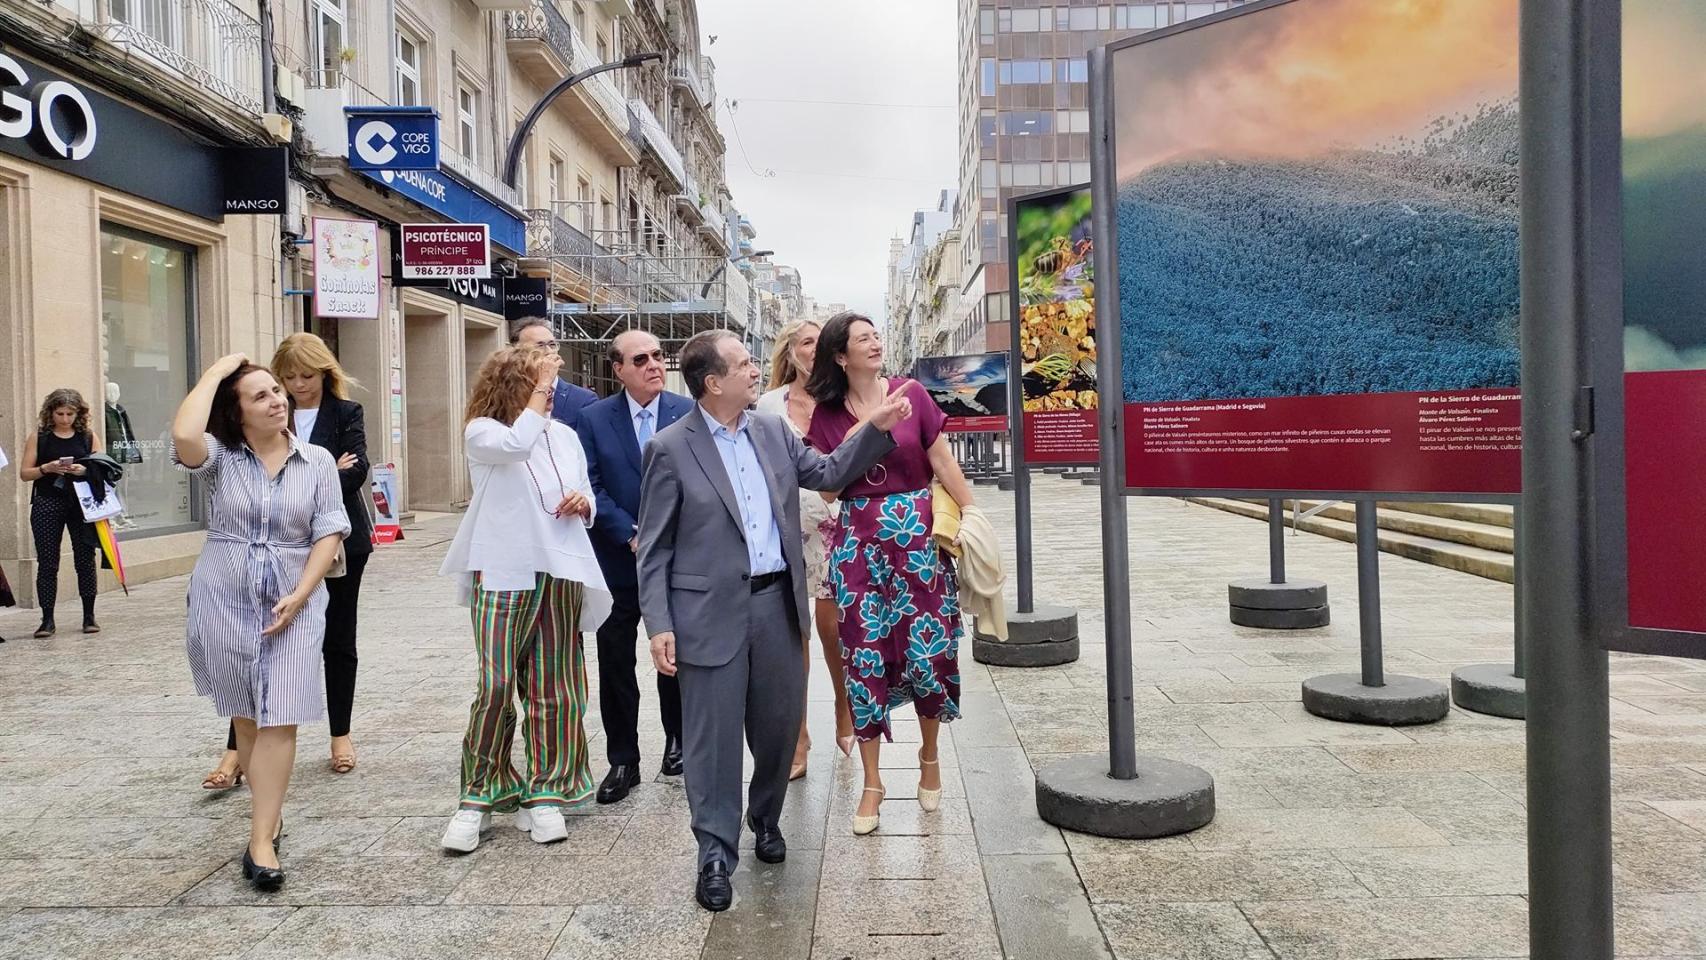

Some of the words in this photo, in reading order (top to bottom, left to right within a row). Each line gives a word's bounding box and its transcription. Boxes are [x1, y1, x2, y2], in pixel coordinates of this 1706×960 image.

[402, 132, 430, 143] COPE
[402, 143, 431, 154] VIGO
[427, 178, 447, 202] COPE
[226, 199, 279, 209] MANGO
[405, 229, 482, 243] PSICOTÉCNICO
[420, 246, 469, 256] PRÍNCIPE
[415, 266, 434, 275] 986
[436, 266, 454, 275] 227
[457, 266, 475, 275] 888
[320, 275, 376, 295] Gominolas
[482, 284, 496, 298] MAN
[506, 294, 544, 302] MANGO
[328, 297, 367, 313] Snack
[1182, 404, 1215, 412] Guadarrama
[1216, 403, 1237, 411] (Madrid
[1242, 402, 1266, 411] Segovia)
[112, 440, 131, 449] BACK
[131, 440, 141, 449] TO
[141, 439, 166, 449] SCHOOL
[1473, 443, 1500, 451] historia,
